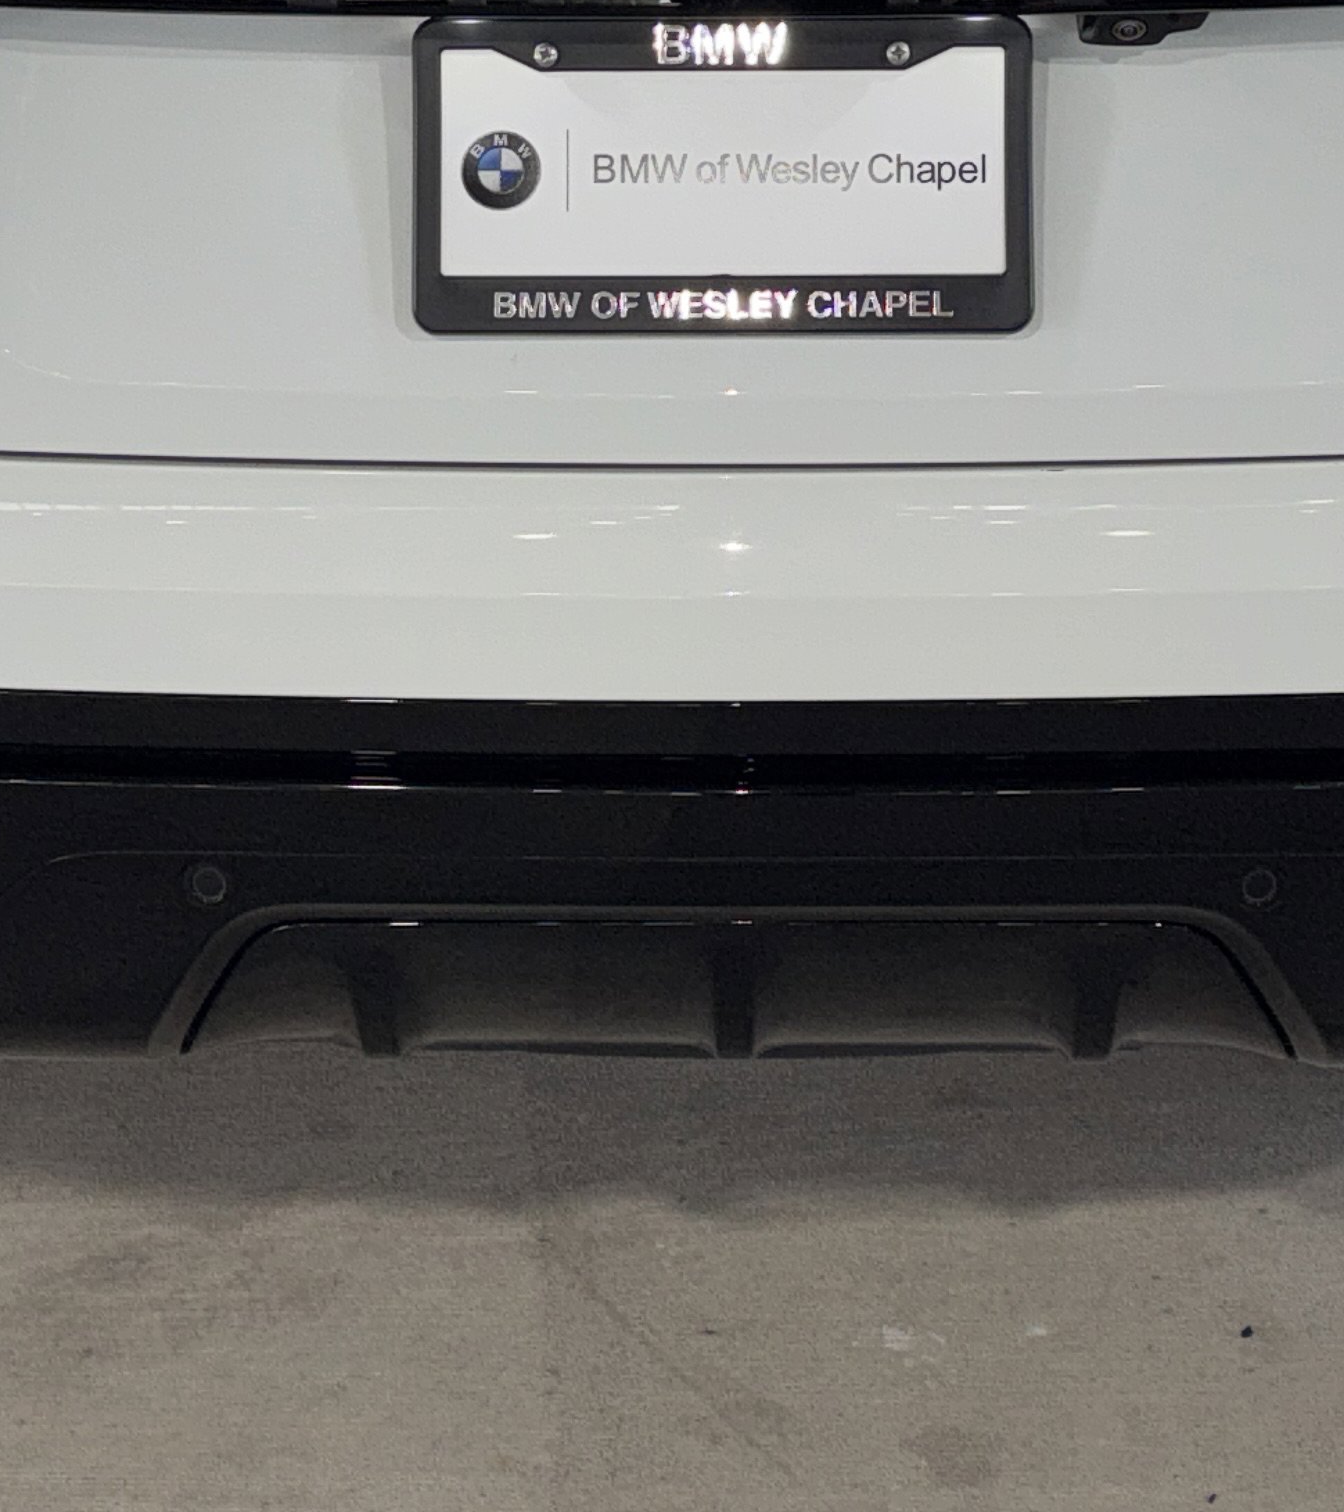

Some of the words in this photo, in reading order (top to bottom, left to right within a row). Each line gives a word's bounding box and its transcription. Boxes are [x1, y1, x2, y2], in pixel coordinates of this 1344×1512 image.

[654, 22, 788, 65] BMW
[470, 135, 532, 159] BMW
[593, 154, 688, 184] BMW
[696, 152, 729, 184] of
[736, 153, 859, 191] Wesley
[868, 153, 987, 191] Chapel
[493, 290, 581, 320] BMW
[591, 290, 640, 319] OF
[650, 289, 798, 320] WESLEY
[806, 290, 955, 319] CHAPEL
